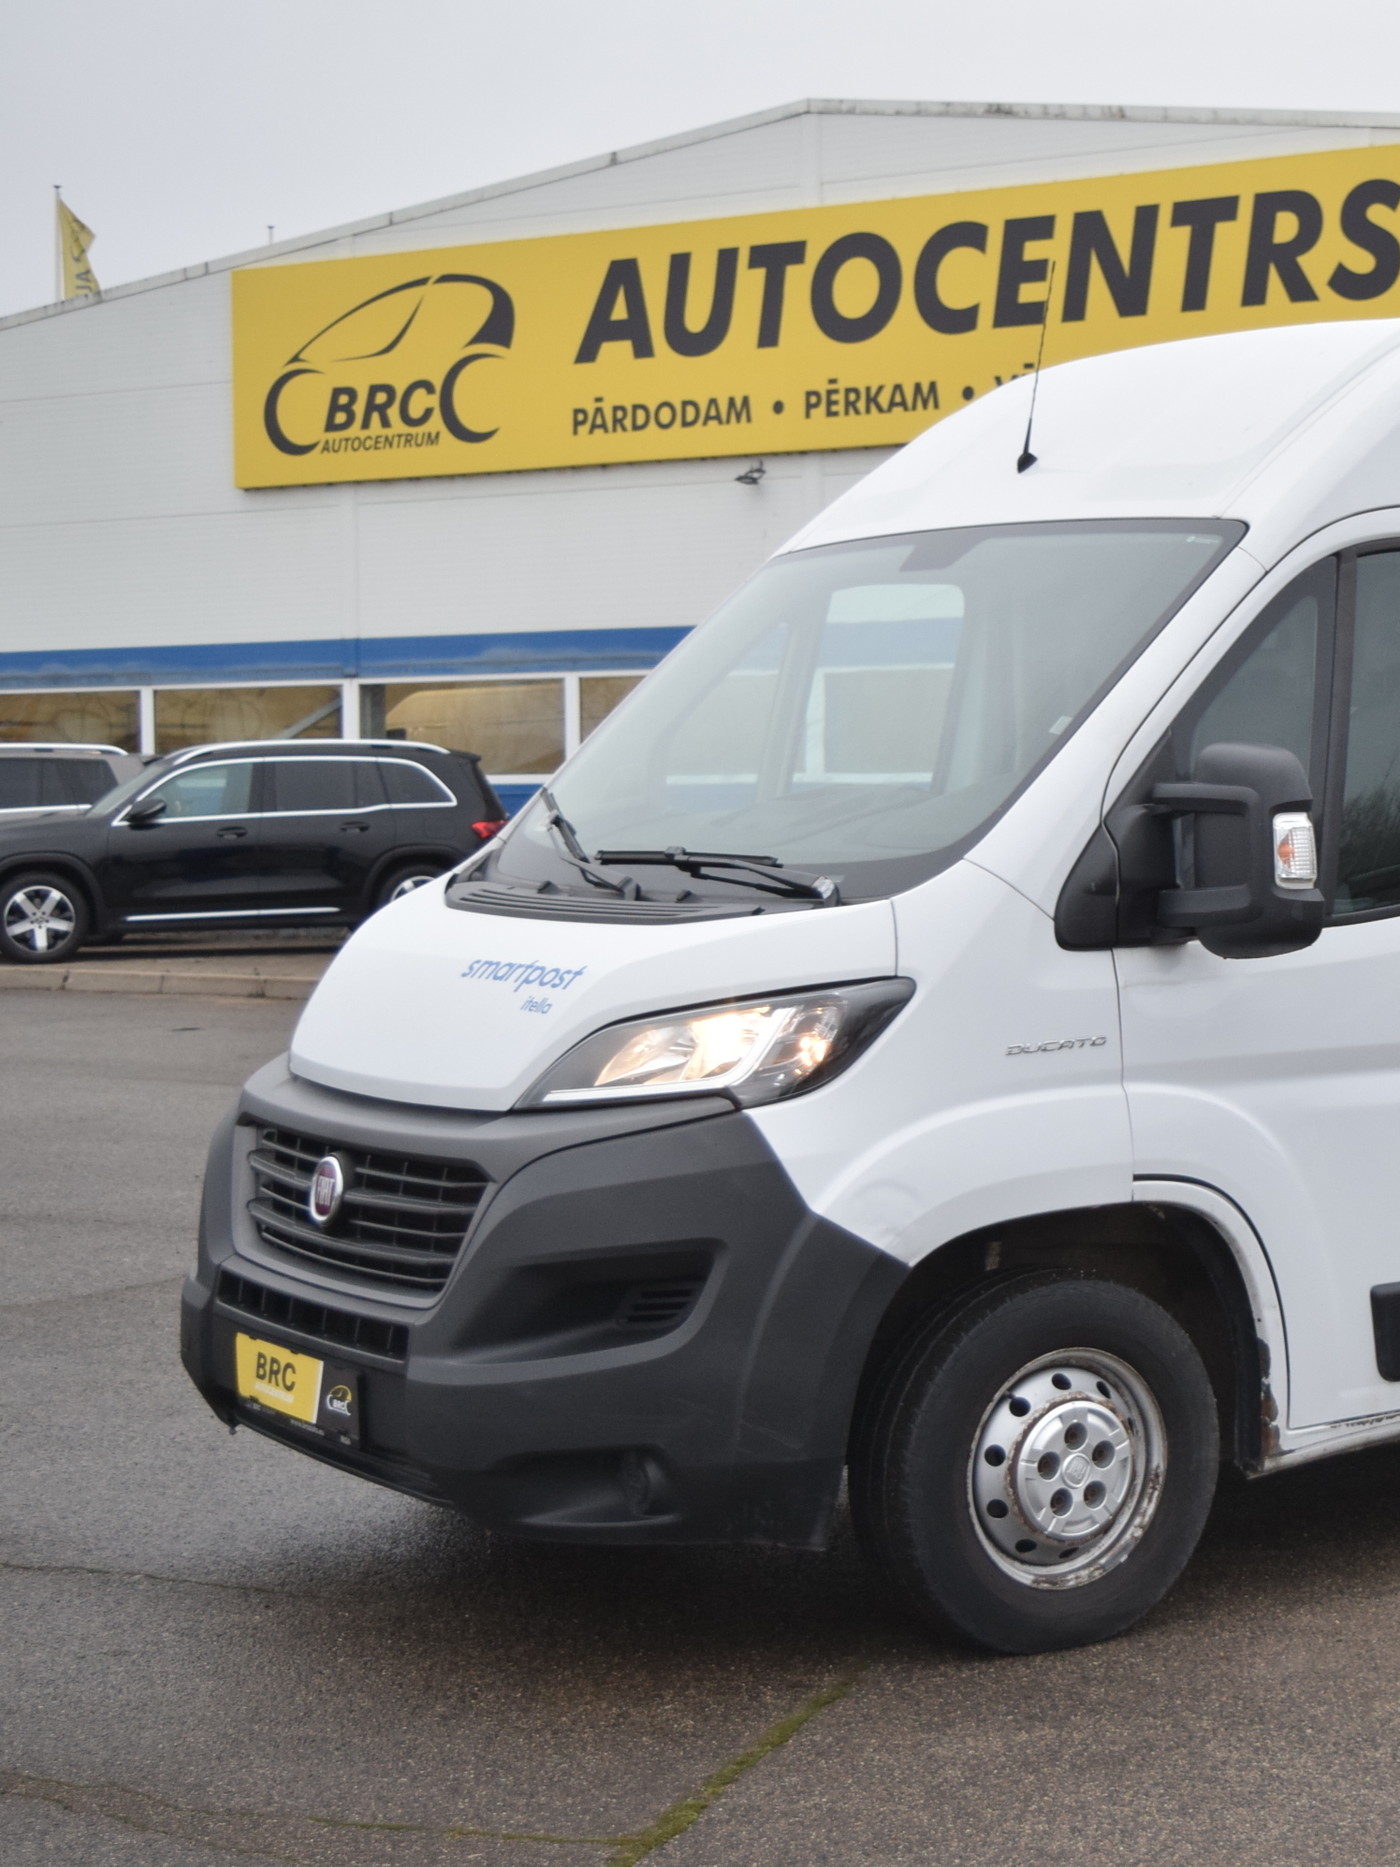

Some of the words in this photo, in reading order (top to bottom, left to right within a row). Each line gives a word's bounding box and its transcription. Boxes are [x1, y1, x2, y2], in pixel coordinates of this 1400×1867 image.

[324, 378, 437, 434] BRC
[572, 396, 752, 436] PĀRDODAM
[804, 378, 940, 419] PĒRKAM
[320, 430, 441, 454] AUTOCENTRUM
[460, 959, 588, 992] smartpost
[520, 996, 553, 1014] itella
[1005, 1036, 1108, 1056] DUCATO
[256, 1352, 296, 1392] BRC
